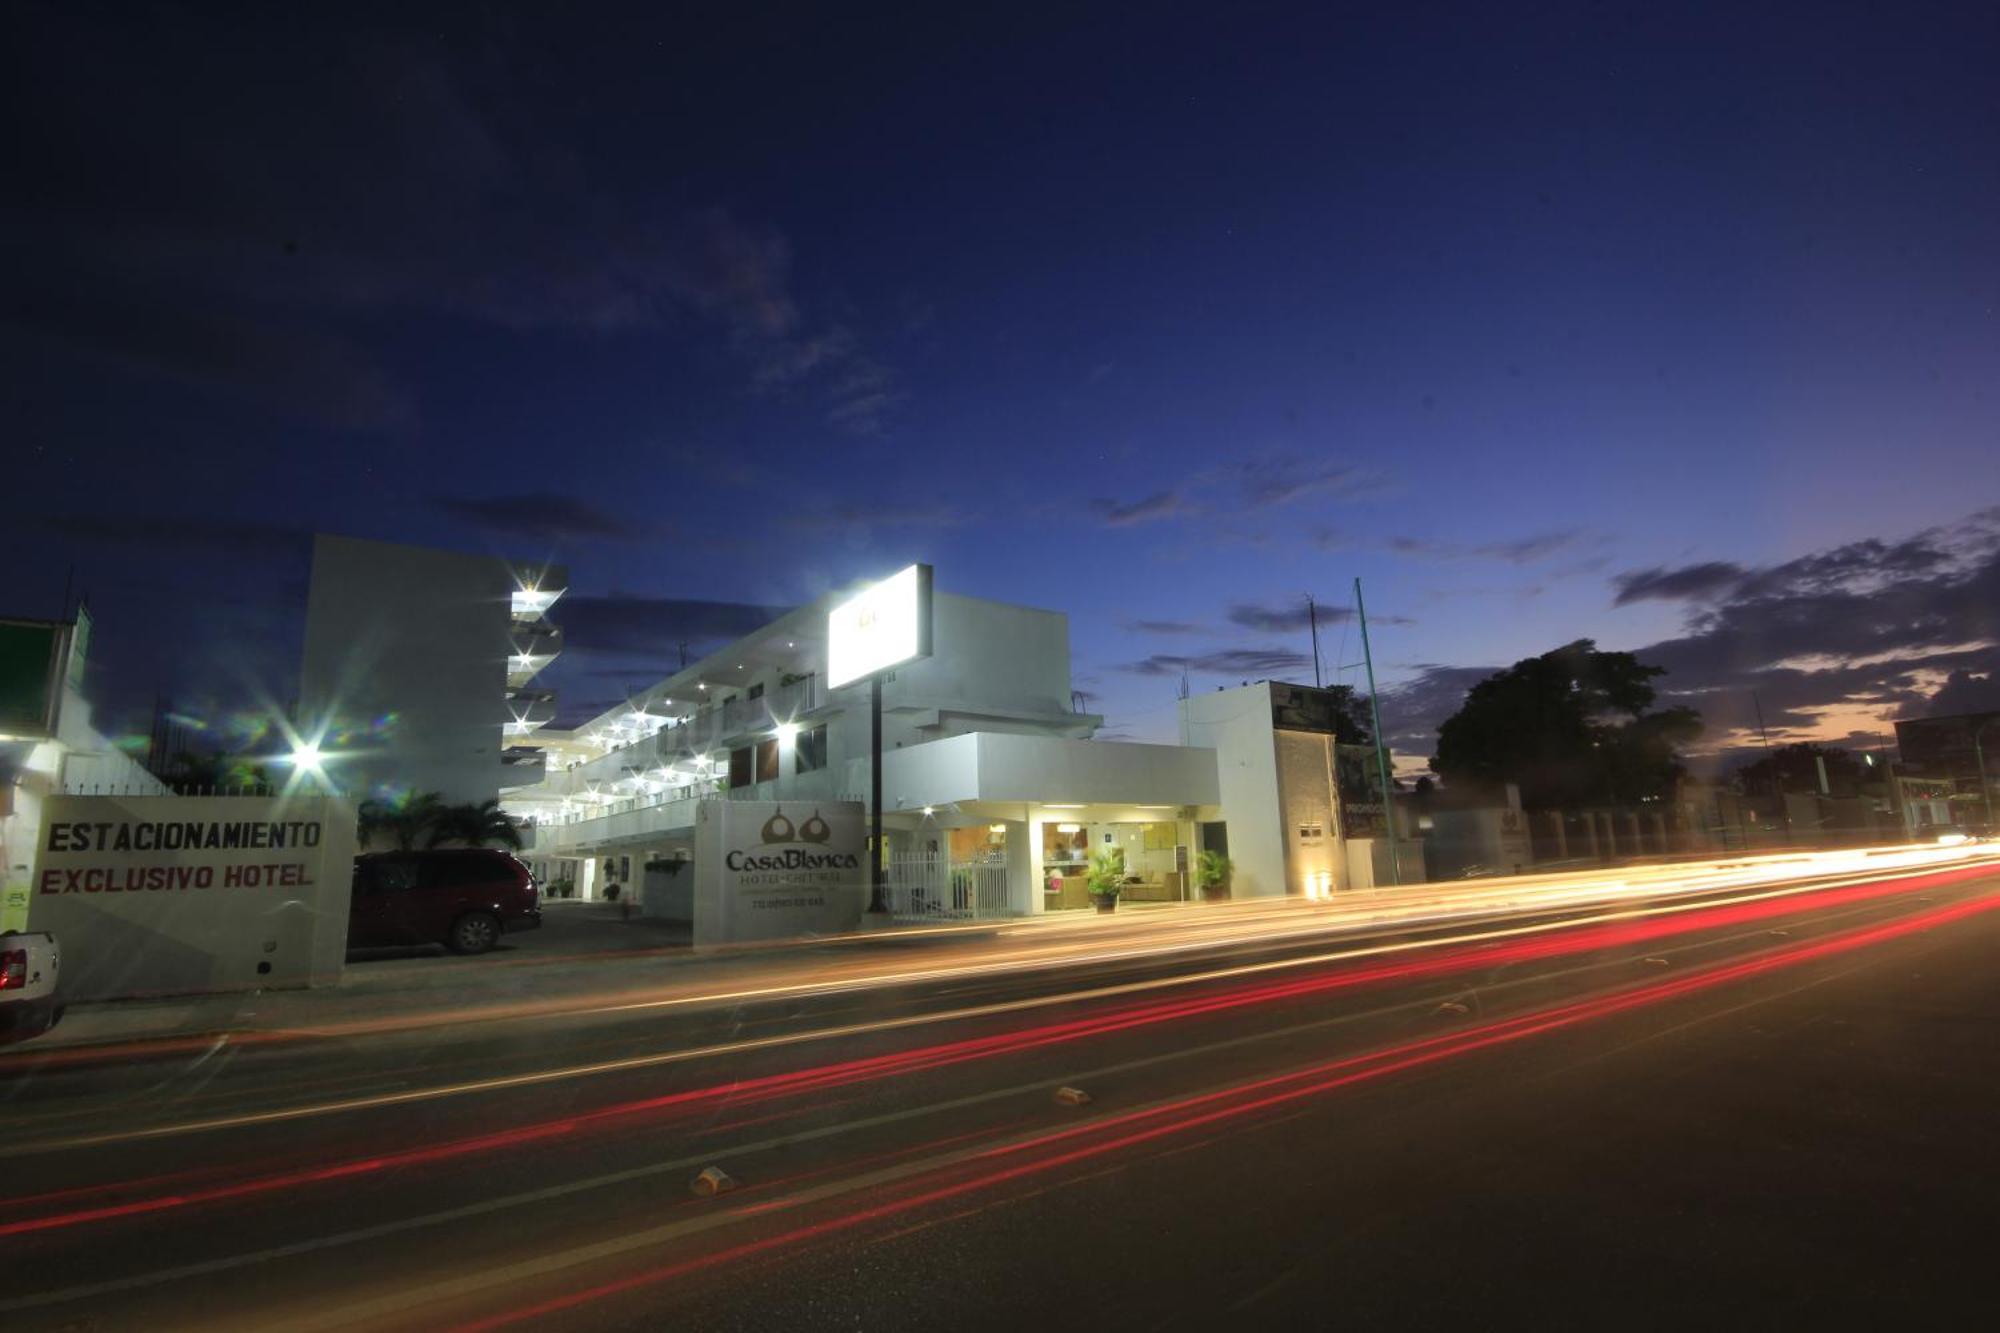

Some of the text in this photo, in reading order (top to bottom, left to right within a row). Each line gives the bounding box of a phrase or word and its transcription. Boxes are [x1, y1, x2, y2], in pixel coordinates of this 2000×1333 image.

[47, 822, 321, 851] ESTACIONAMIENTO
[726, 850, 858, 872] CasaBlanca
[40, 864, 314, 895] EXCLUSIVO HOTEL
